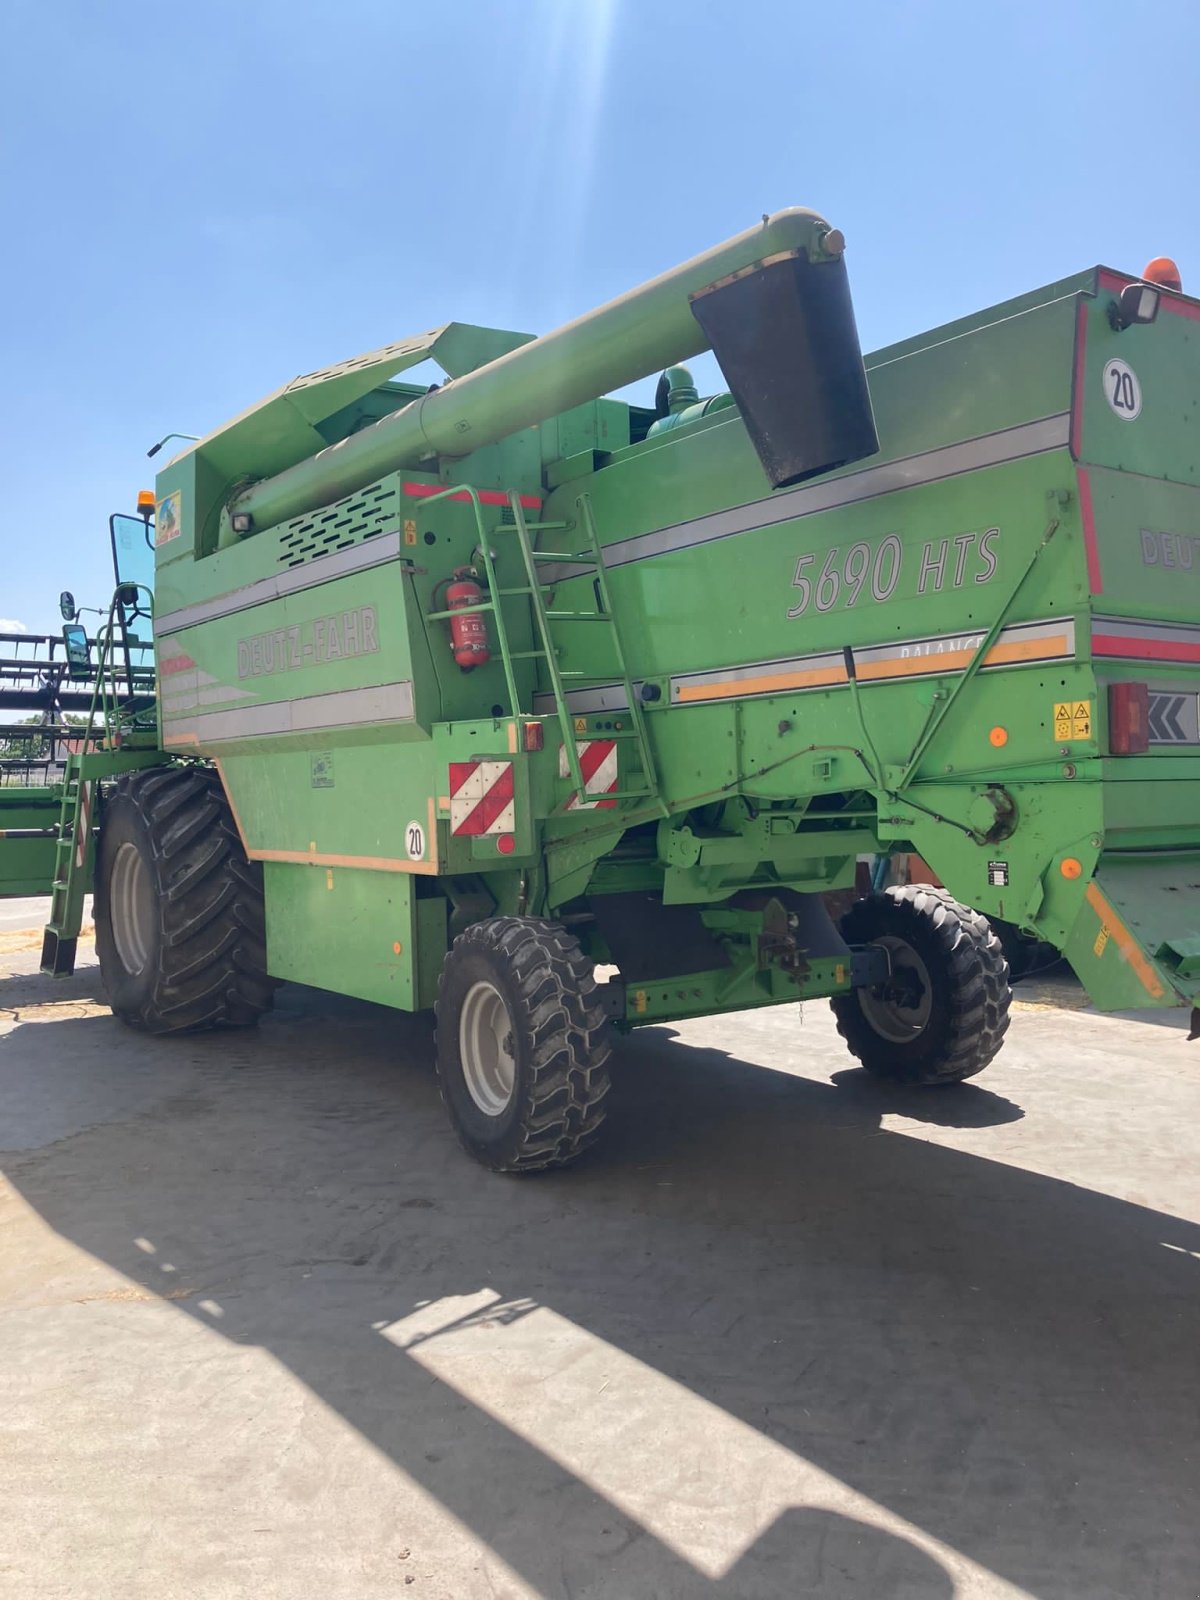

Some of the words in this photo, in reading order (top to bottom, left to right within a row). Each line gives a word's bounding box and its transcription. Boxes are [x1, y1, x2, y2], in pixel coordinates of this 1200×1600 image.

[1110, 368, 1135, 411] 20
[787, 533, 902, 620] 5690
[917, 528, 999, 594] HTS
[237, 606, 379, 680] DEUTZ-FAHR
[409, 828, 422, 856] 20
